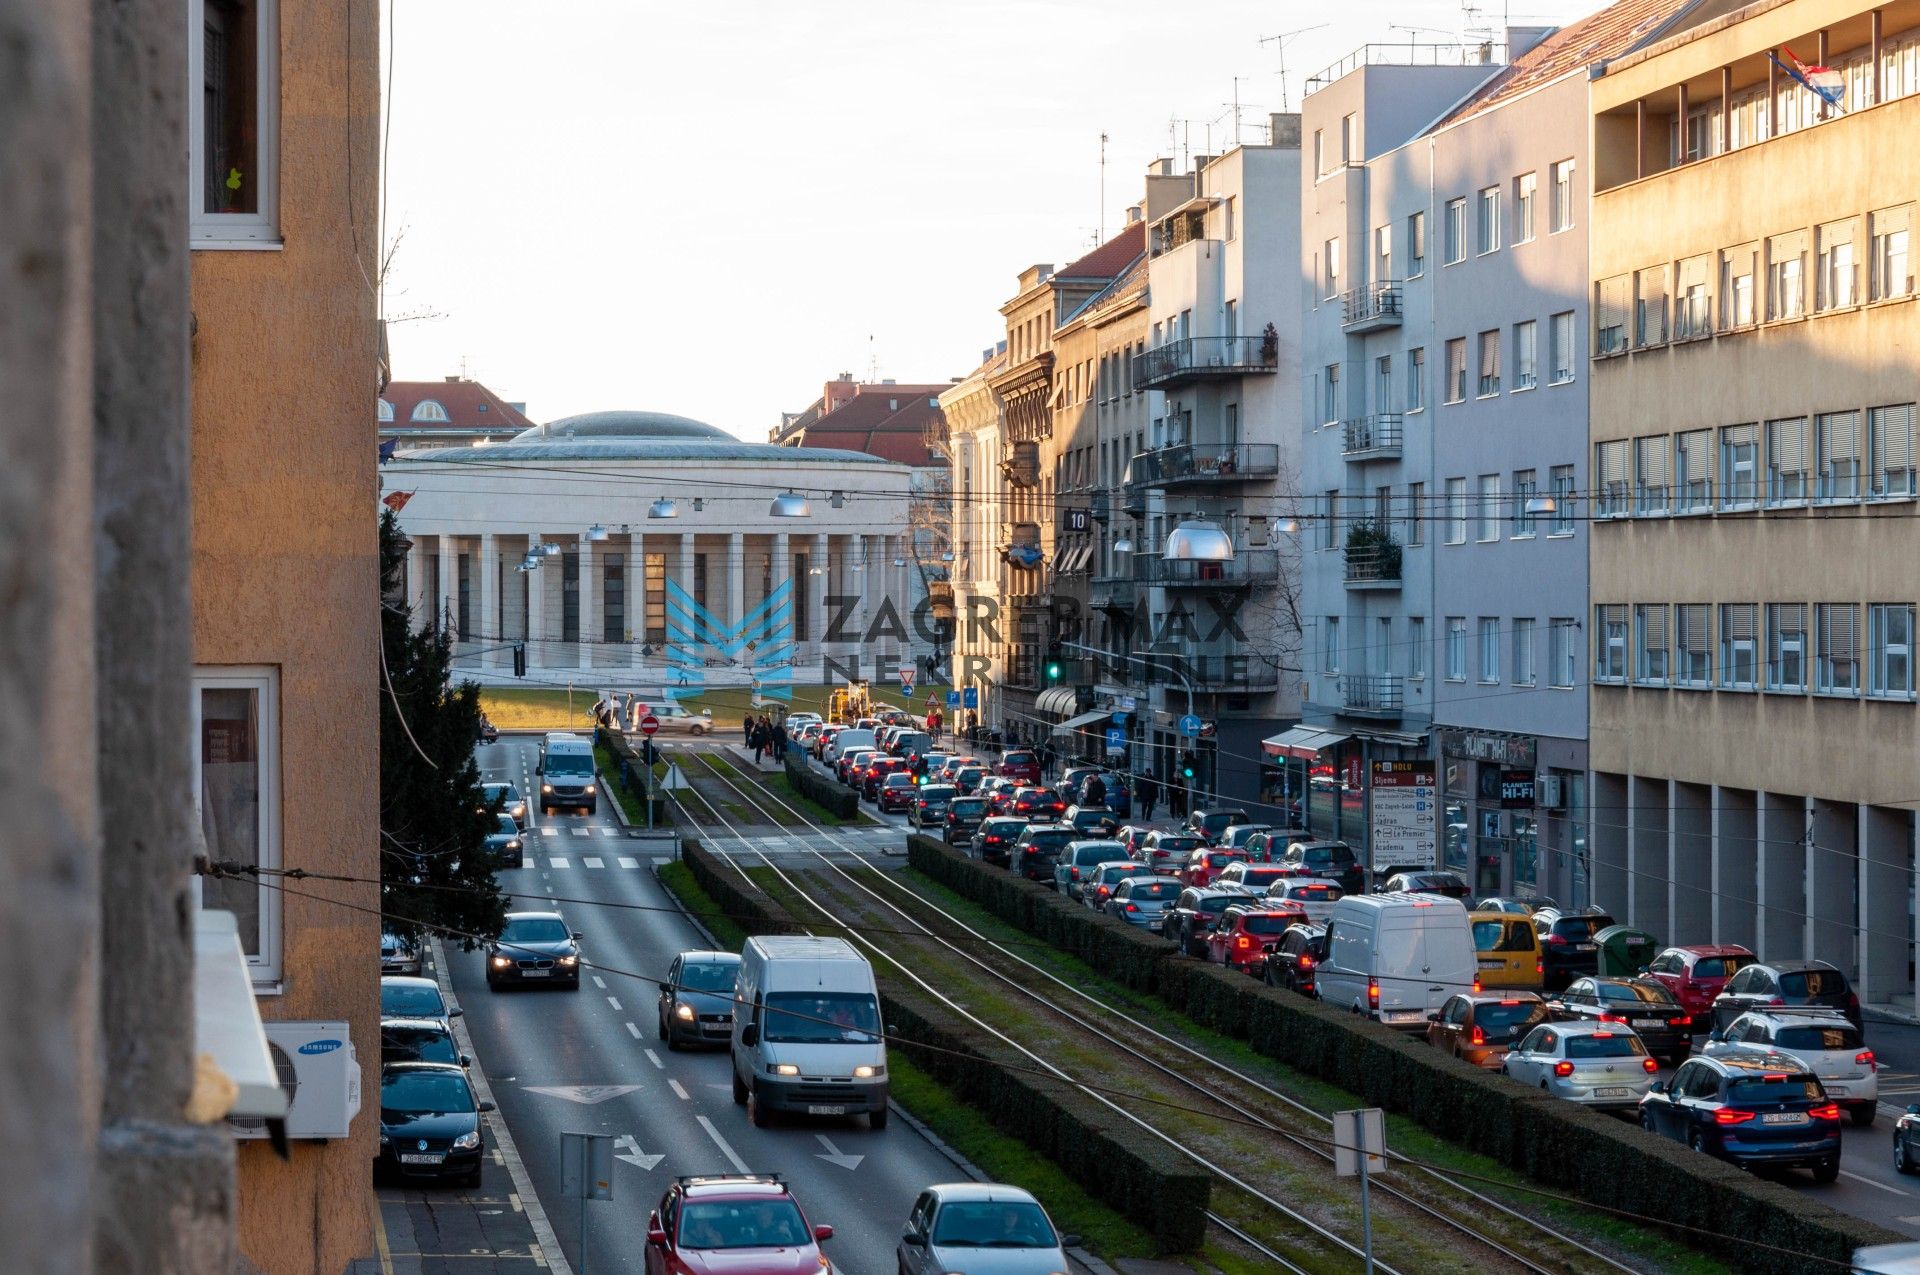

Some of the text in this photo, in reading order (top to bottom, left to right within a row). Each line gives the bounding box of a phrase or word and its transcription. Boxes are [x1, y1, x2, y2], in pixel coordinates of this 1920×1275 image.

[1071, 513, 1084, 529] 10
[1112, 732, 1119, 743] P
[1374, 776, 1397, 786] Sljeme
[1502, 787, 1534, 799] HI-FI
[1375, 817, 1398, 825] Jadran
[1375, 843, 1404, 851] Academia
